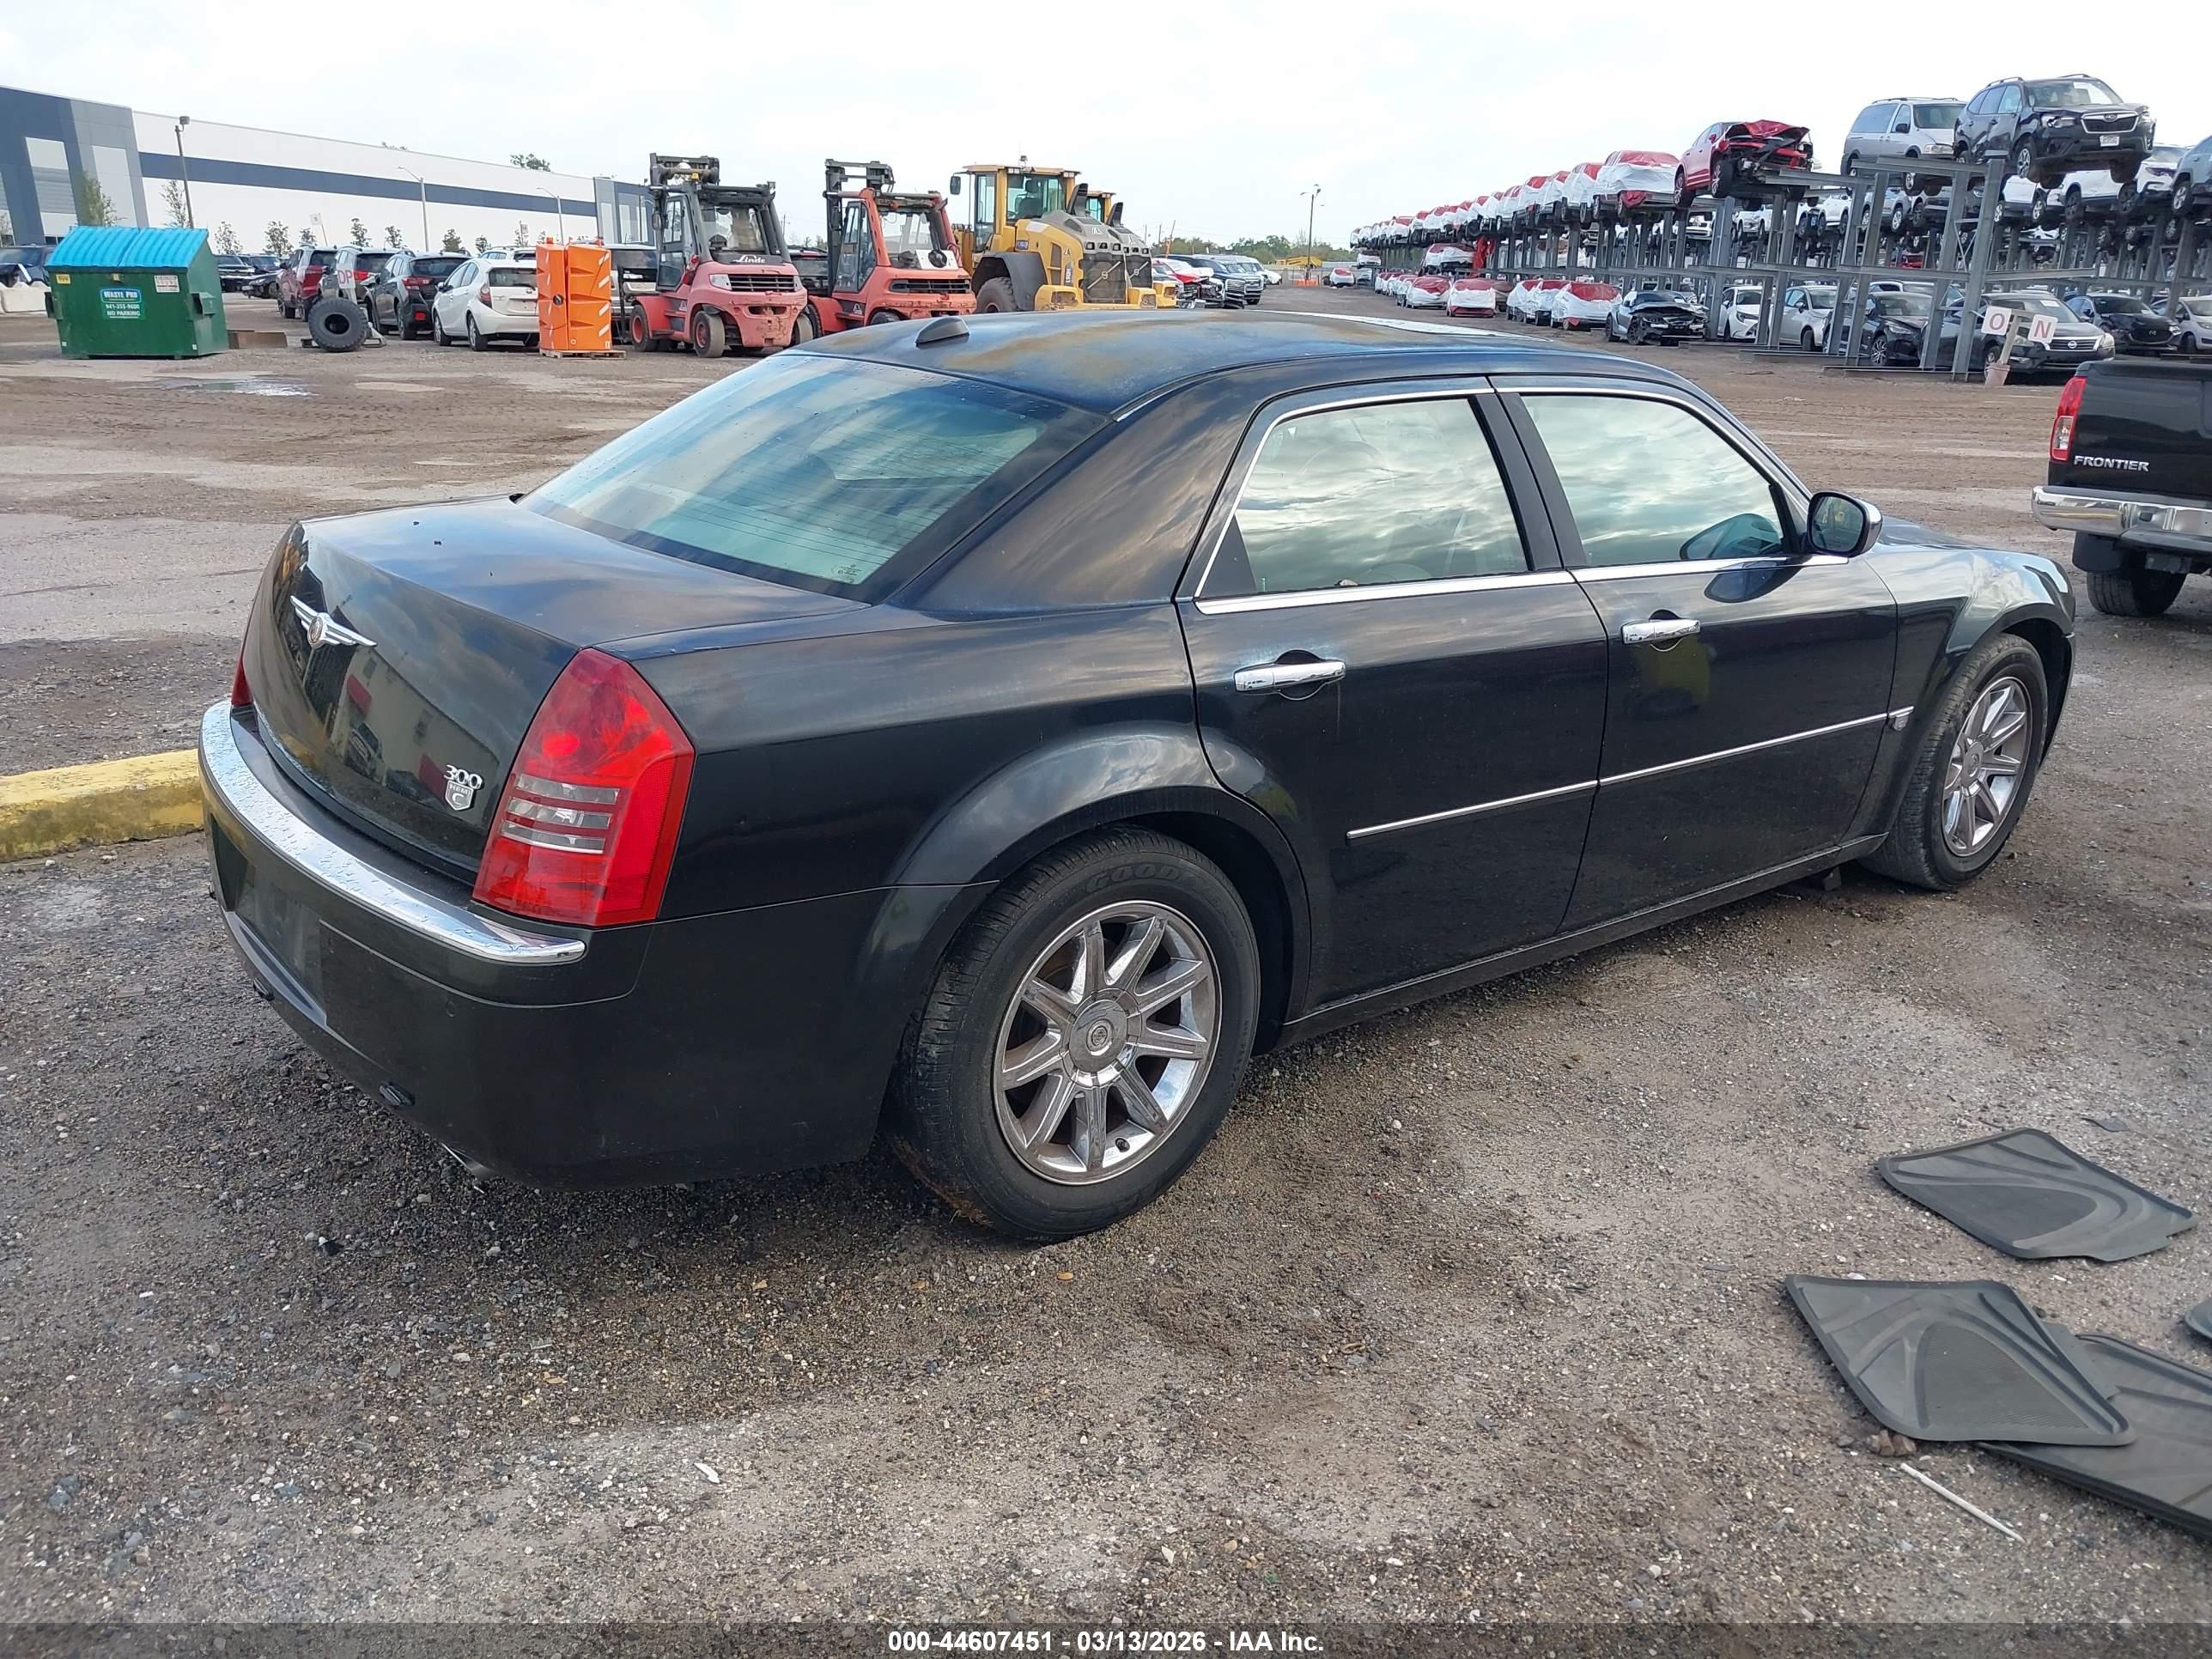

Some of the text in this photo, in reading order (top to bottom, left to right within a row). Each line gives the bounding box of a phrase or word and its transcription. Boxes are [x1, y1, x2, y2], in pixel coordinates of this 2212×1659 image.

[732, 254, 765, 263] Linde
[337, 270, 352, 283] DP
[1990, 313, 2006, 331] O
[2033, 320, 2052, 339] N
[2074, 455, 2149, 471] FRONTIER
[443, 764, 483, 789] 300
[452, 793, 465, 805] C
